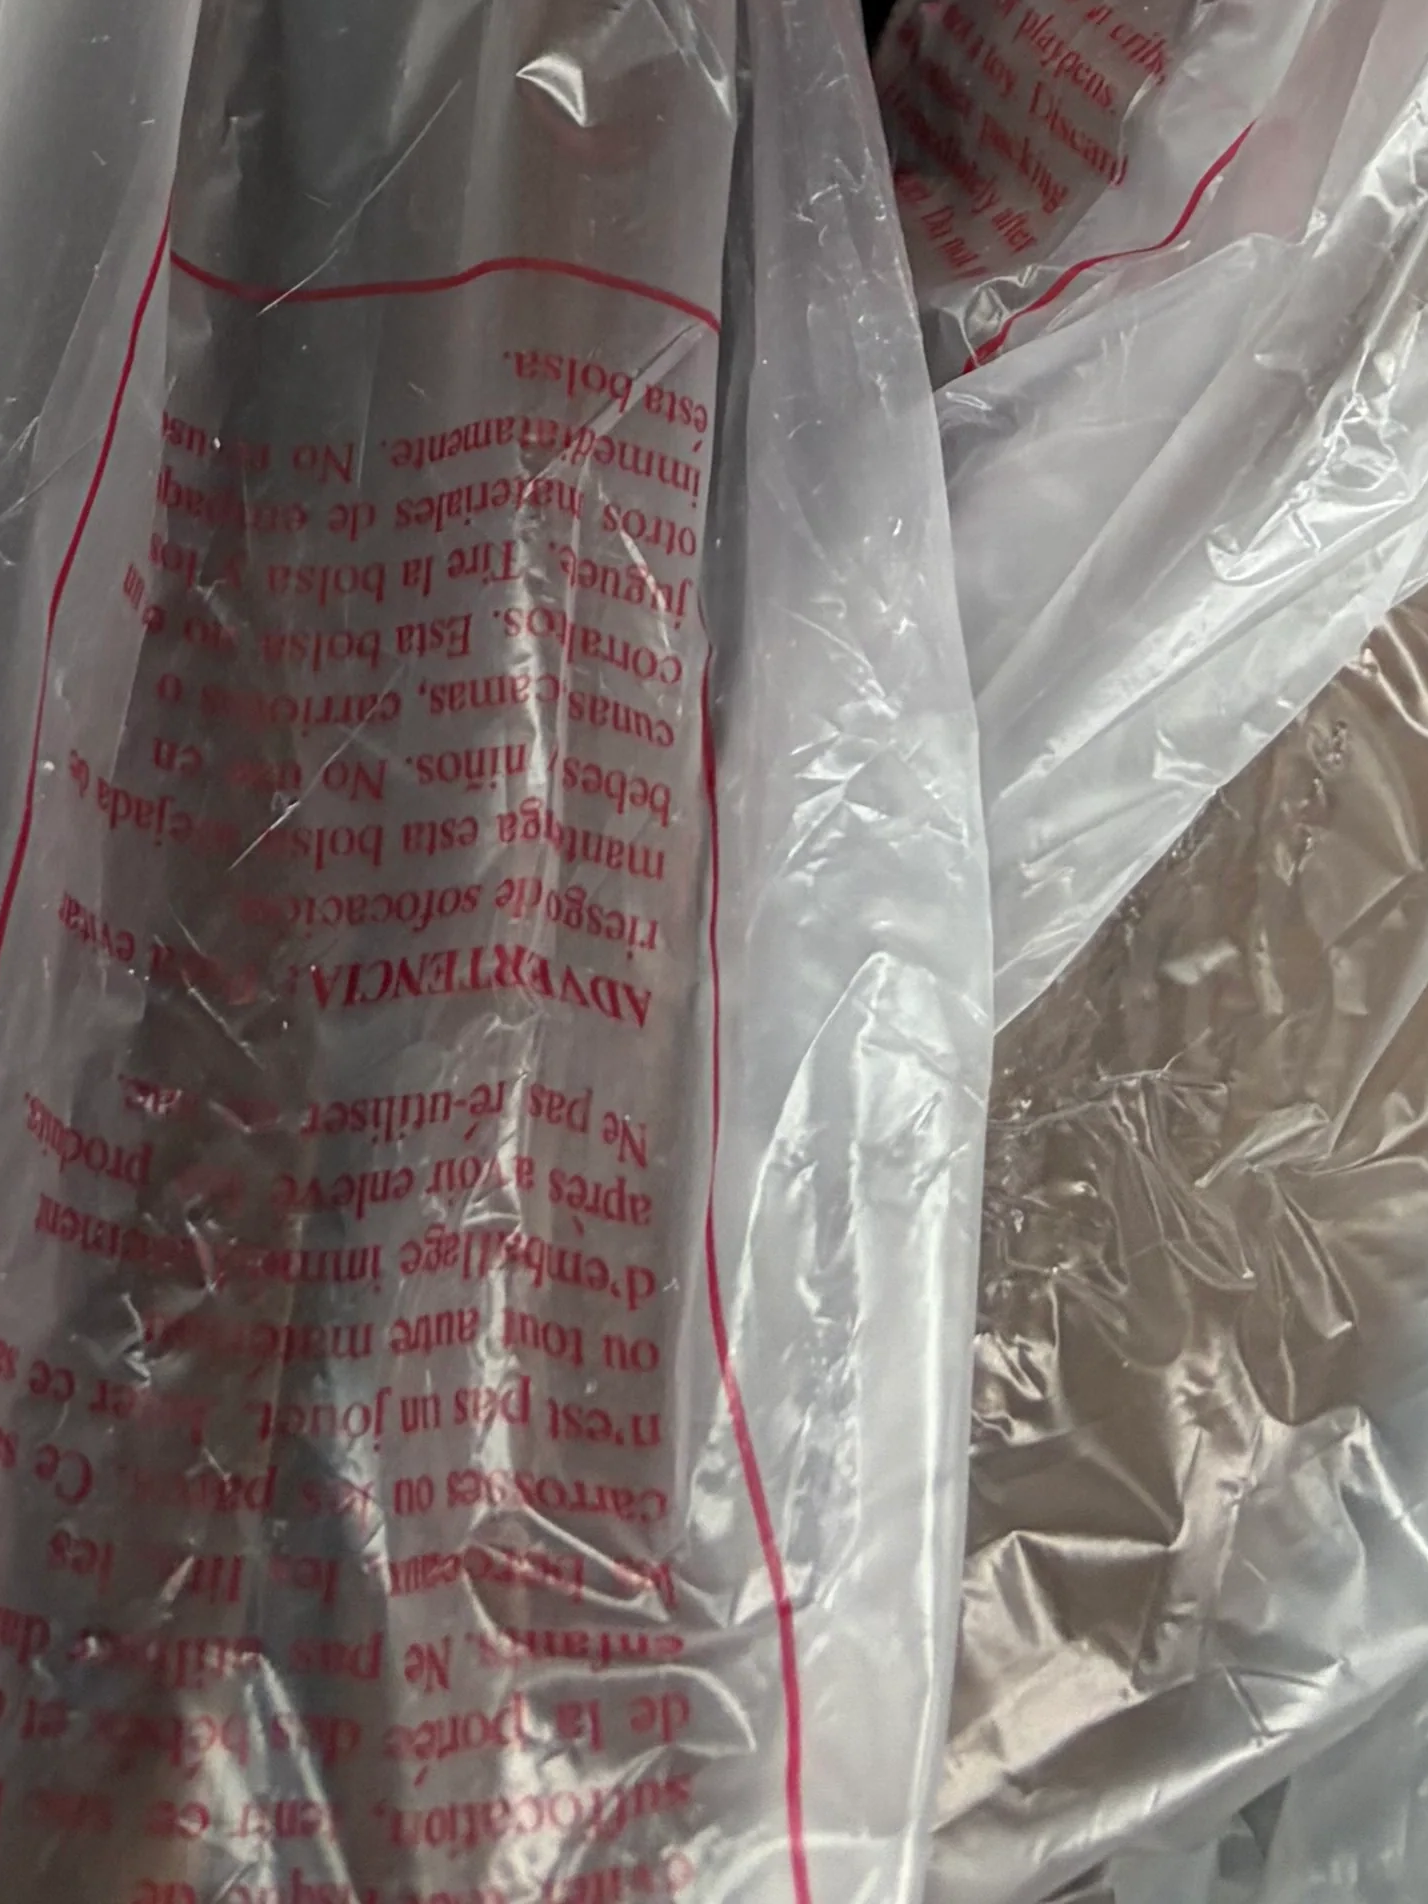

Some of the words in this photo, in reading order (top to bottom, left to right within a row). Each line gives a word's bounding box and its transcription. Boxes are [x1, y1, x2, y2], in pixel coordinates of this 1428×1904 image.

[502, 349, 637, 421] bolsa.
[643, 385, 710, 452] ésta
[292, 440, 356, 485] No
[327, 499, 378, 543] de
[601, 500, 699, 563] otros
[267, 563, 385, 609] bolsa
[400, 553, 436, 592] la
[446, 536, 524, 586] Tire
[395, 612, 473, 662] Esta
[418, 672, 562, 715] camas,
[321, 758, 390, 803] No
[406, 742, 530, 798] niños.
[562, 756, 672, 827] bebes
[400, 813, 479, 857] esta
[493, 876, 546, 930] de
[545, 886, 660, 962] riesgo
[528, 1082, 595, 1134] pas
[602, 1111, 650, 1167] Ne
[547, 1170, 653, 1228] après
[603, 1335, 660, 1375] ou
[27, 1359, 77, 1405] ce
[400, 1393, 442, 1443] un
[546, 1399, 662, 1452] n'est
[33, 1443, 94, 1507] Ce
[393, 1474, 434, 1522] ou
[404, 1640, 453, 1693] Ne
[628, 1692, 691, 1747] de
